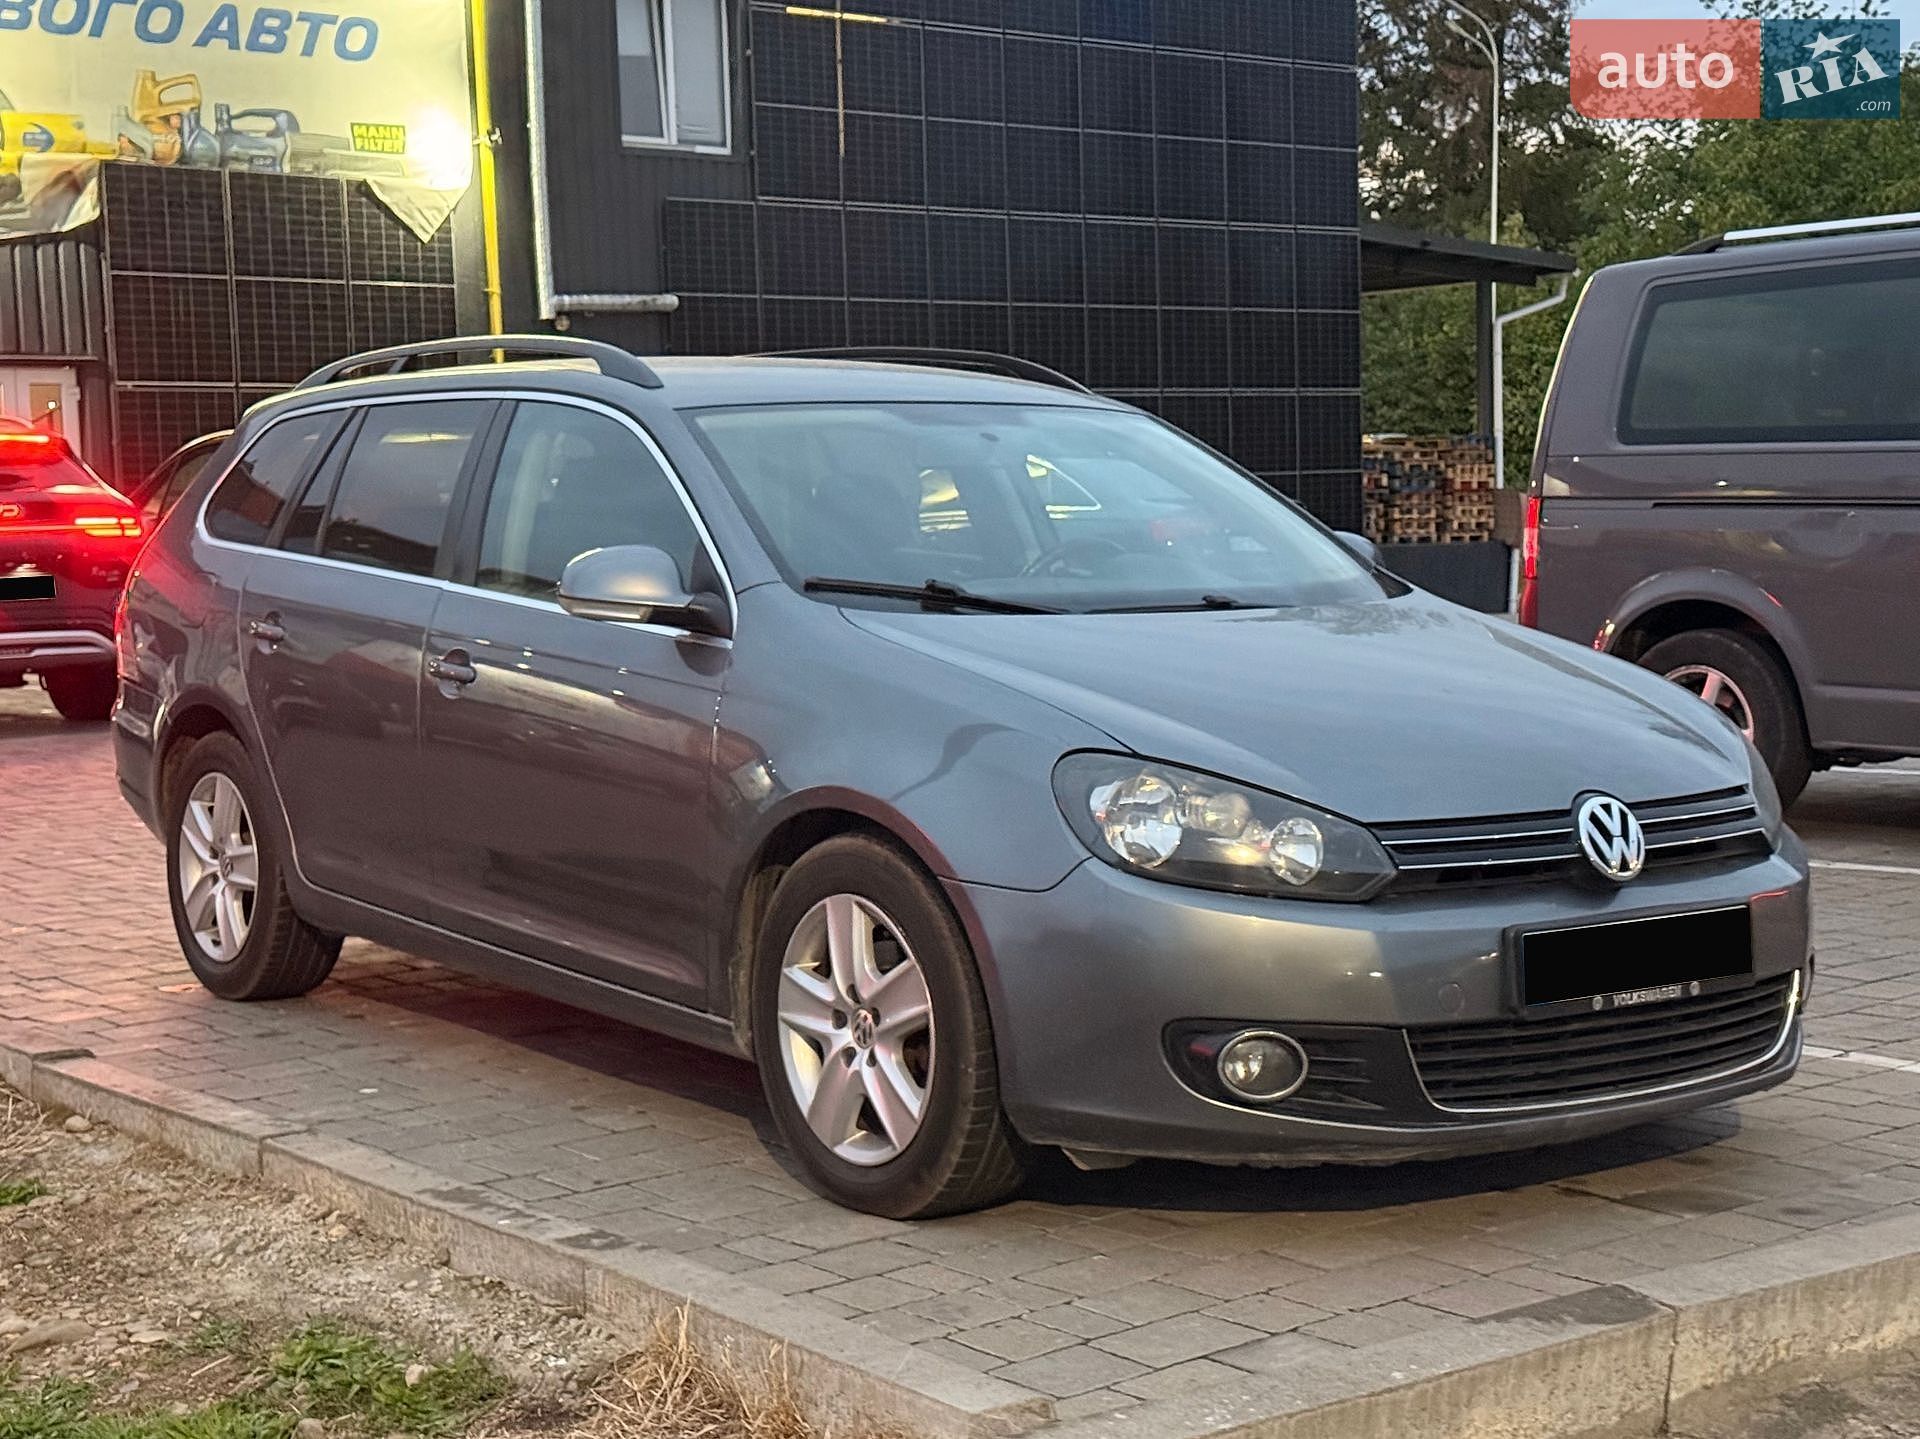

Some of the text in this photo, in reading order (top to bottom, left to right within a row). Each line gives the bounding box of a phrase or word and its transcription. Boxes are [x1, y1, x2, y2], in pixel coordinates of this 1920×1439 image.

[192, 3, 379, 62] АВТО
[353, 125, 404, 138] MANN
[355, 138, 404, 153] FILTER
